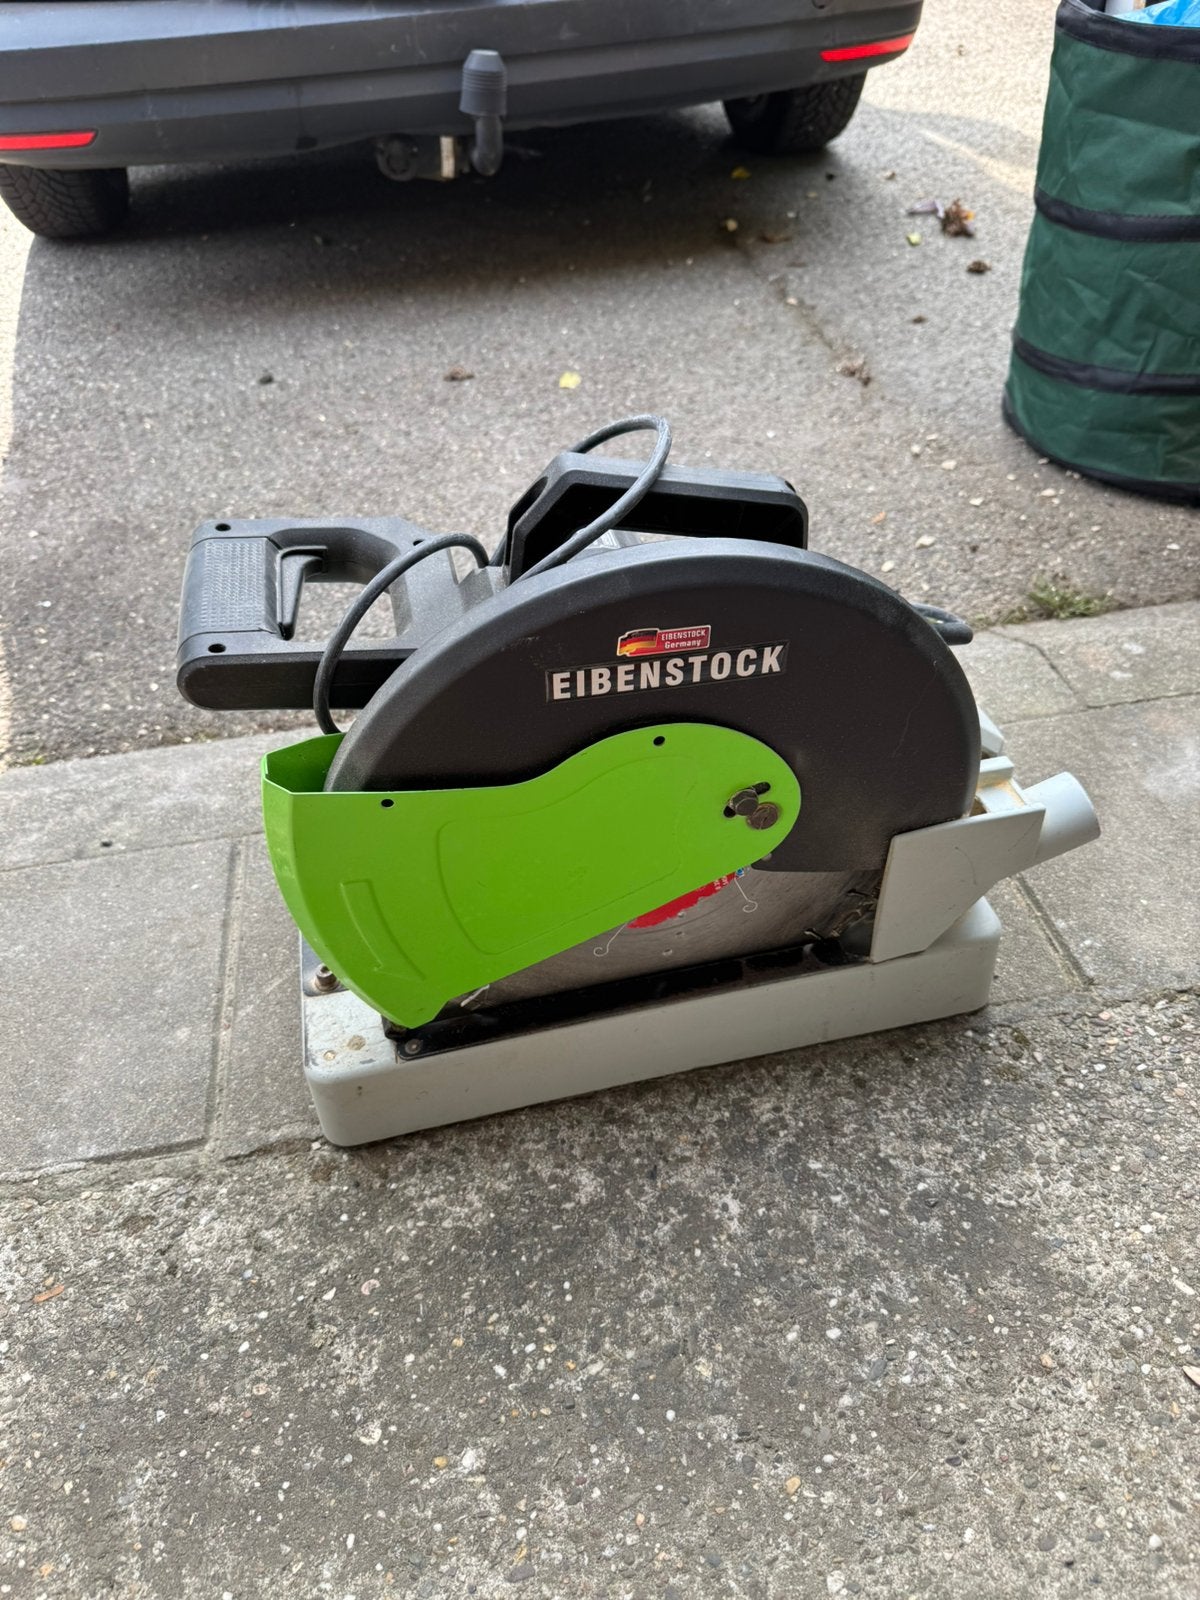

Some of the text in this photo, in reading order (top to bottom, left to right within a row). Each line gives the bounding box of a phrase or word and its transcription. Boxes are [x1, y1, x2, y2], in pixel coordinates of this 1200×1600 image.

[661, 629, 706, 641] EIBENSTOCK
[664, 639, 701, 650] Germany
[552, 645, 784, 700] EIBENSTOCK
